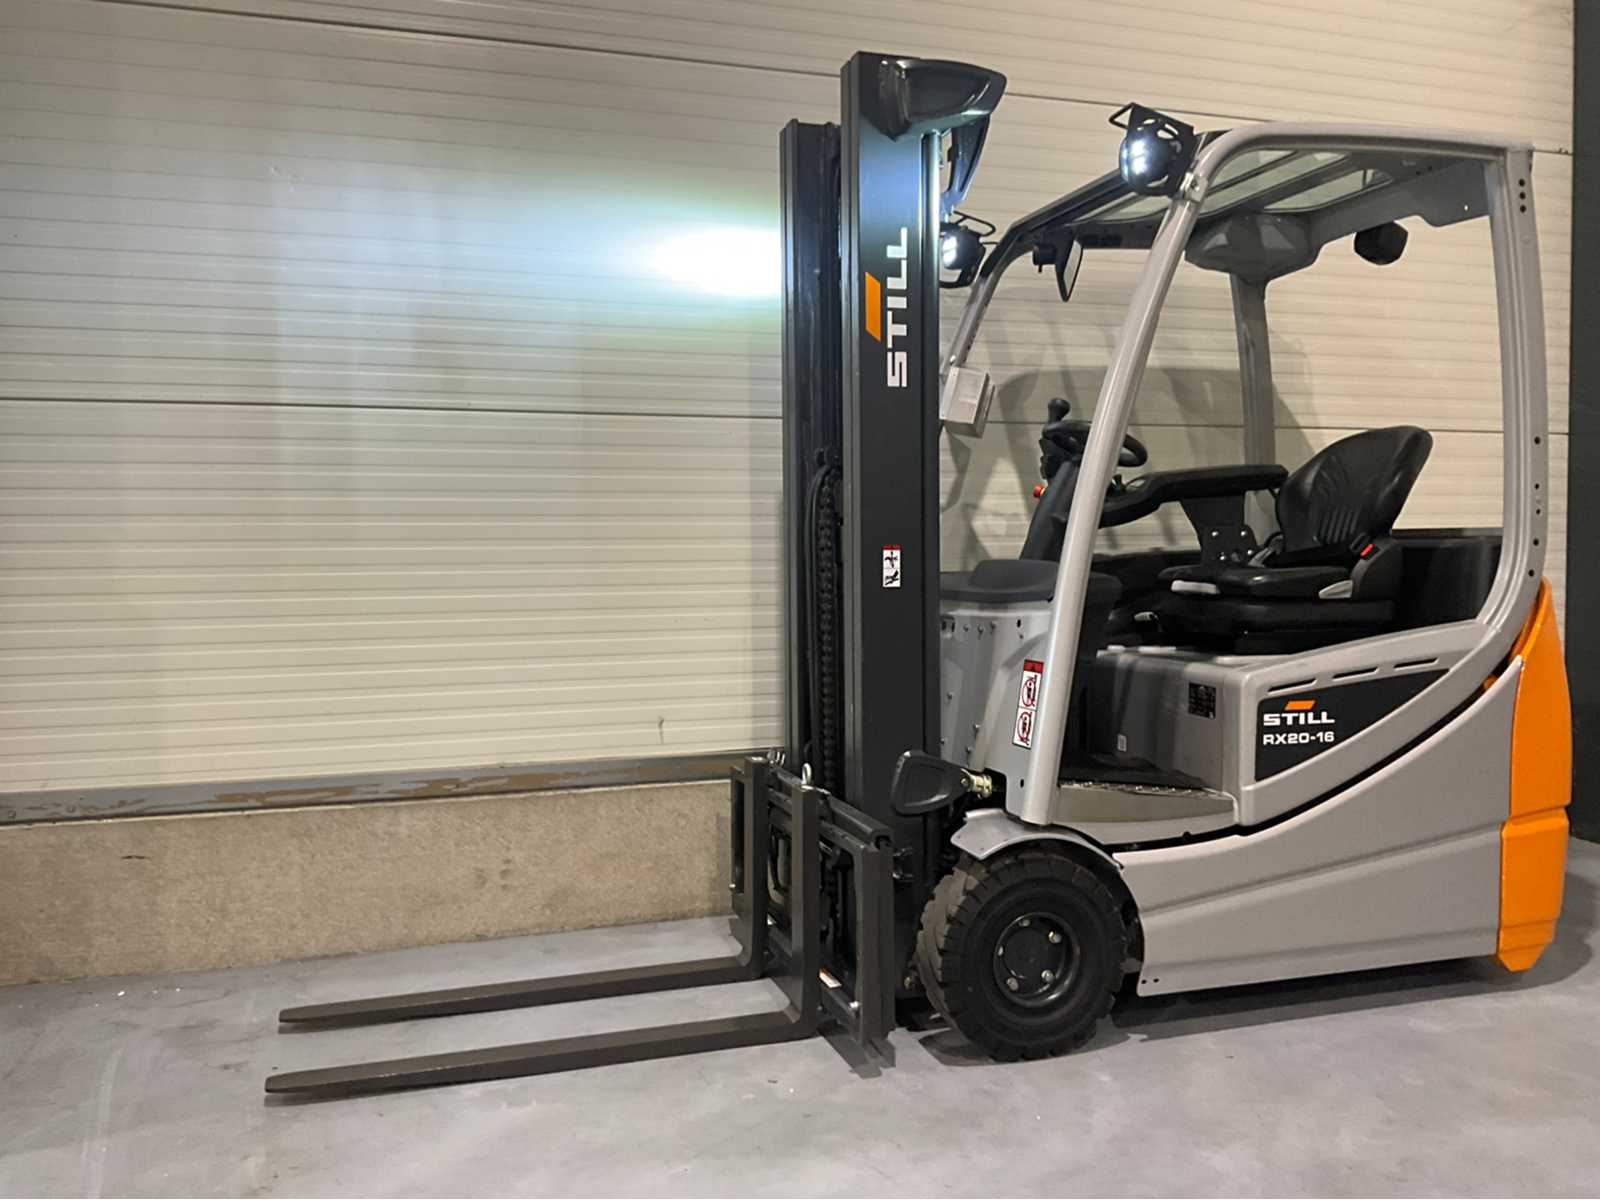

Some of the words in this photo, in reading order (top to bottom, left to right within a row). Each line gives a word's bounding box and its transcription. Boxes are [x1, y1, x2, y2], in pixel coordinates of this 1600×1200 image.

[886, 227, 908, 388] STILL
[1263, 711, 1335, 727] STILL
[1263, 731, 1335, 746] RX20-16
